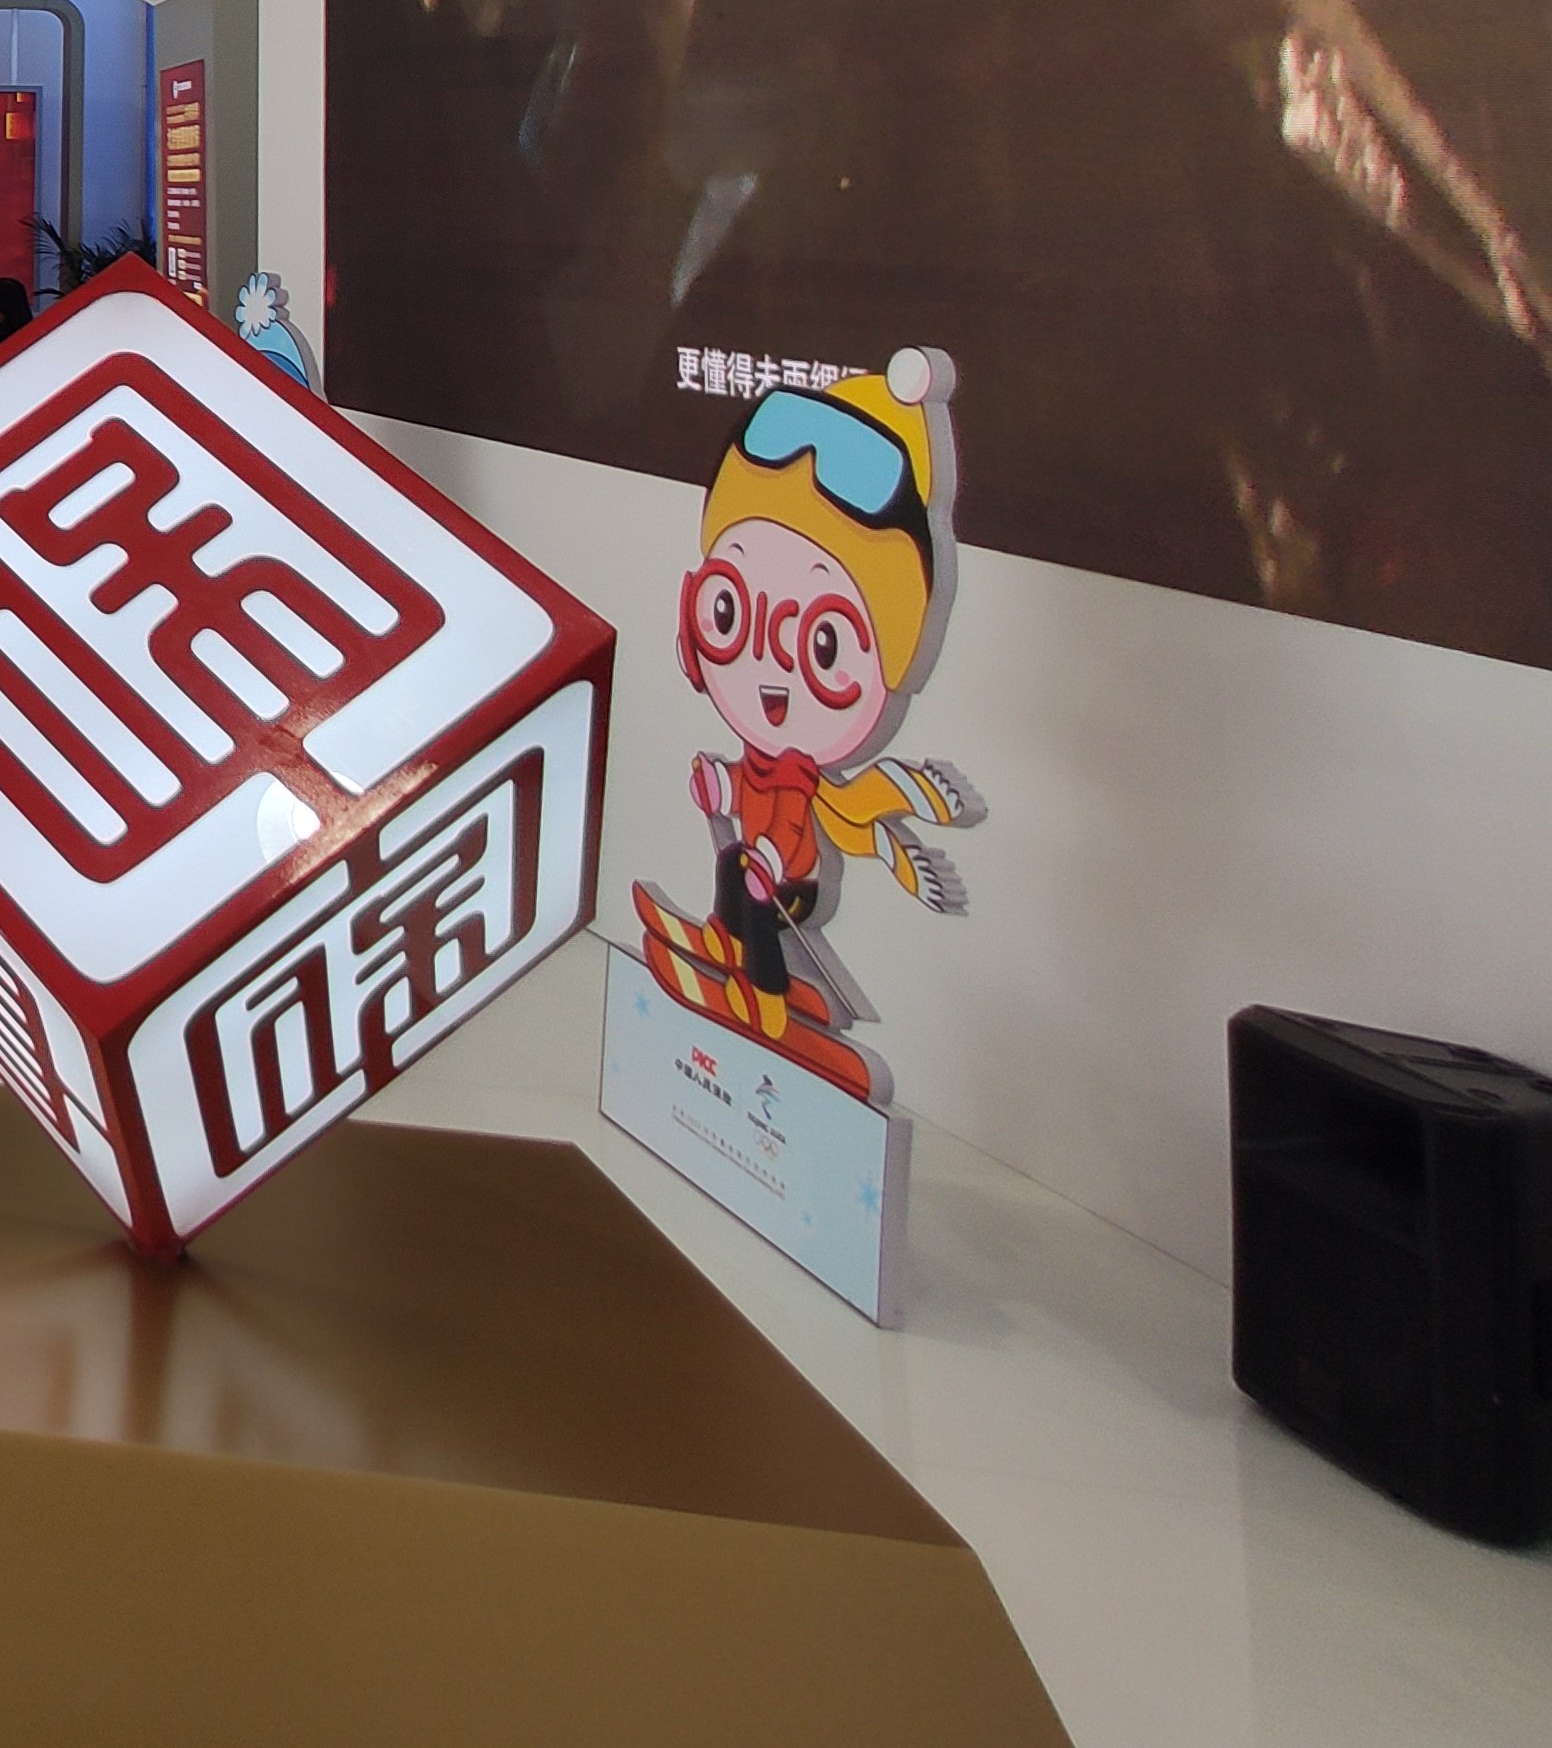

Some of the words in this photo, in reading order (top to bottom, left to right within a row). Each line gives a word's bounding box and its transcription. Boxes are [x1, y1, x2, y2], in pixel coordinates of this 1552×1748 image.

[677, 346, 868, 400] 更懂得未雨绸
